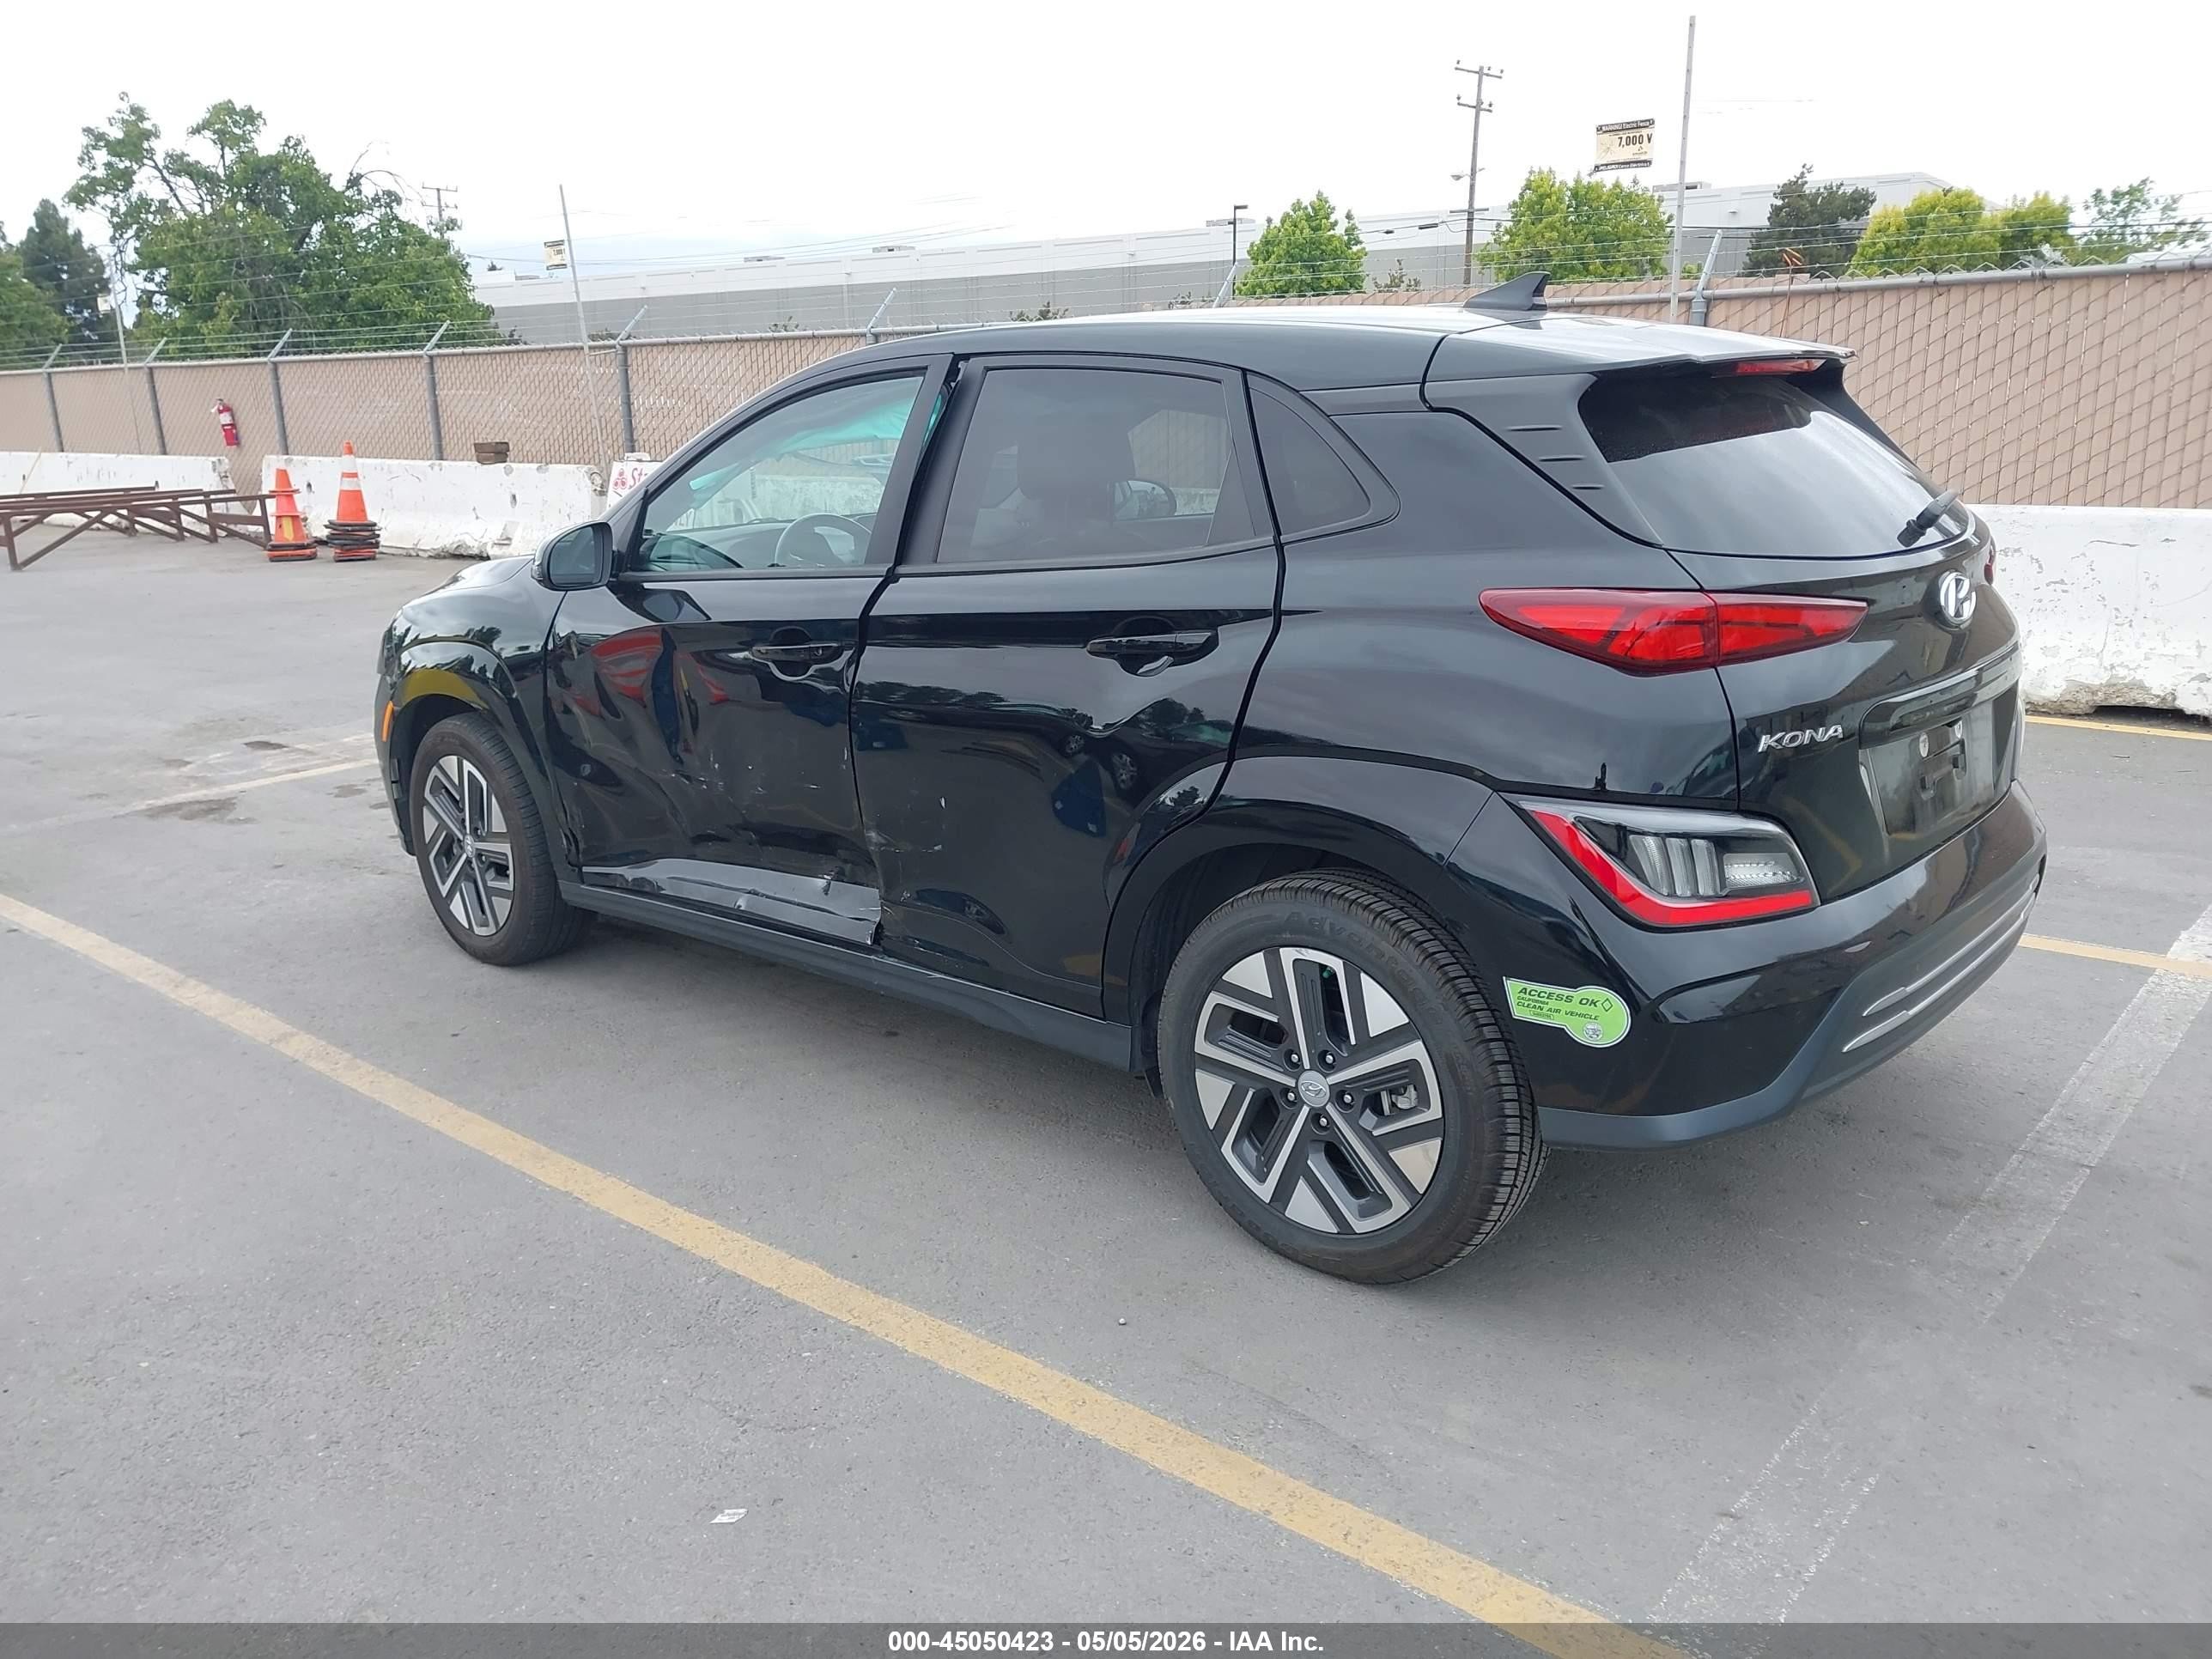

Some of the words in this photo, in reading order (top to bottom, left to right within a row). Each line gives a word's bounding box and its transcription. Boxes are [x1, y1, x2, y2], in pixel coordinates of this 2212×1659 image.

[1618, 134, 1644, 148] 7,000
[1647, 133, 1652, 143] V
[1759, 725, 1844, 753] KONA
[1517, 987, 1574, 1003] ACCESS
[1578, 998, 1601, 1007] OK
[1516, 1001, 1544, 1012] CLEAN
[1565, 1010, 1600, 1021] VEHICLE
